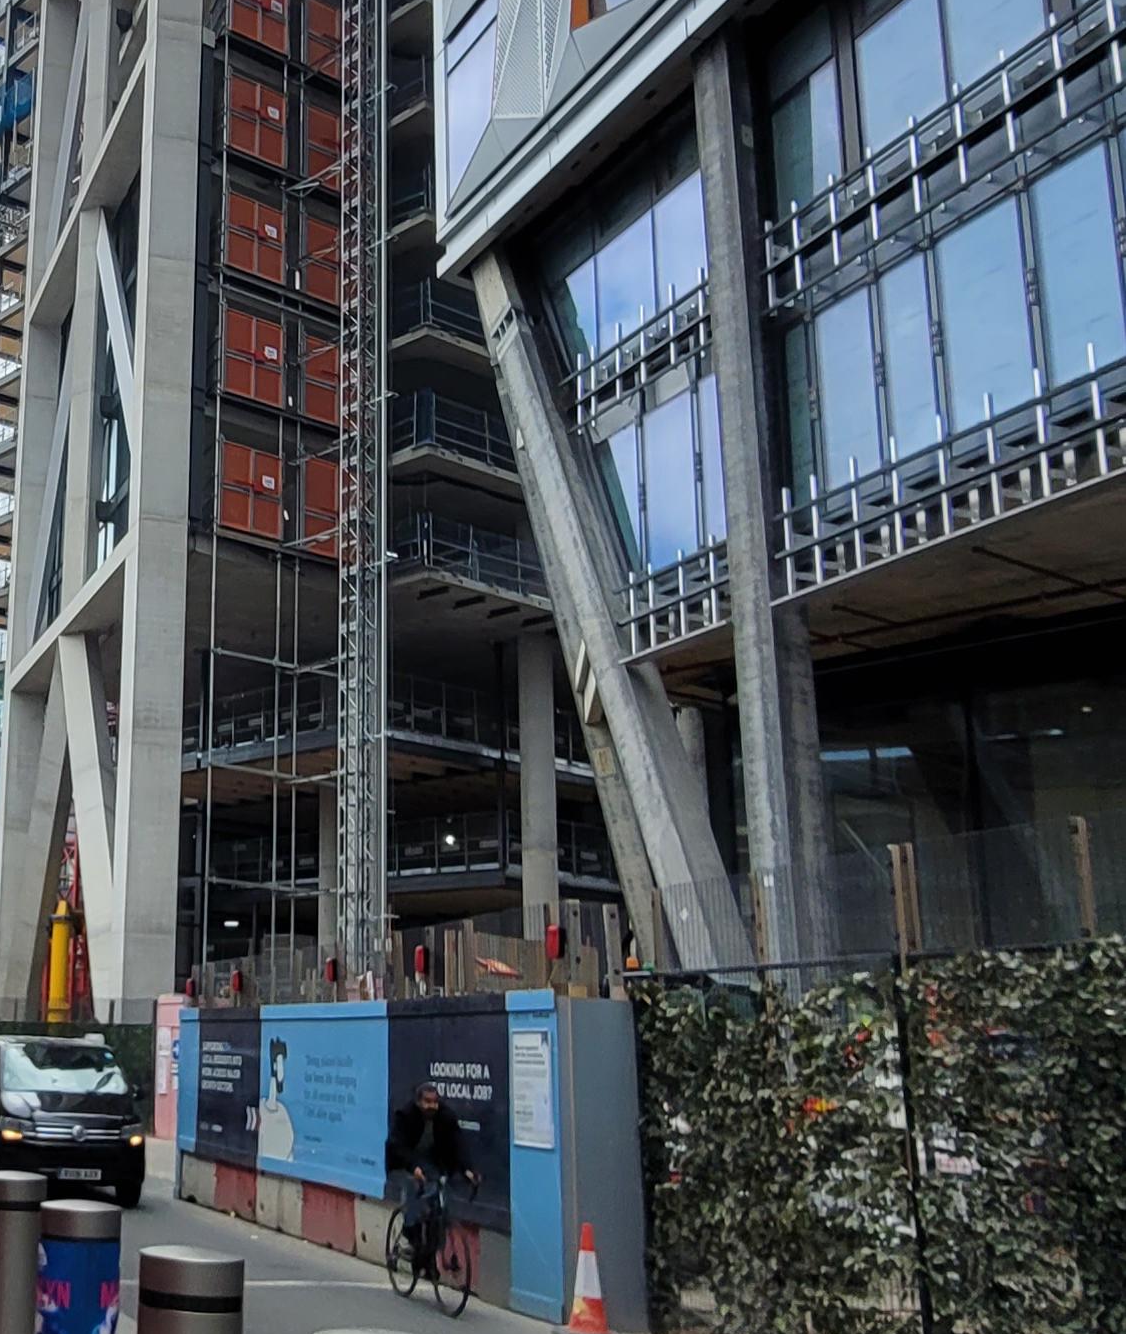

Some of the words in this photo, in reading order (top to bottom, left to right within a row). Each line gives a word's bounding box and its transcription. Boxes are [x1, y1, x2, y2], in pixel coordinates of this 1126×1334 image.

[430, 1062, 465, 1078] LOOKING
[466, 1064, 482, 1080] FOR
[483, 1064, 490, 1080] A
[446, 1082, 471, 1100] LOCAL
[472, 1084, 493, 1101] JOB?
